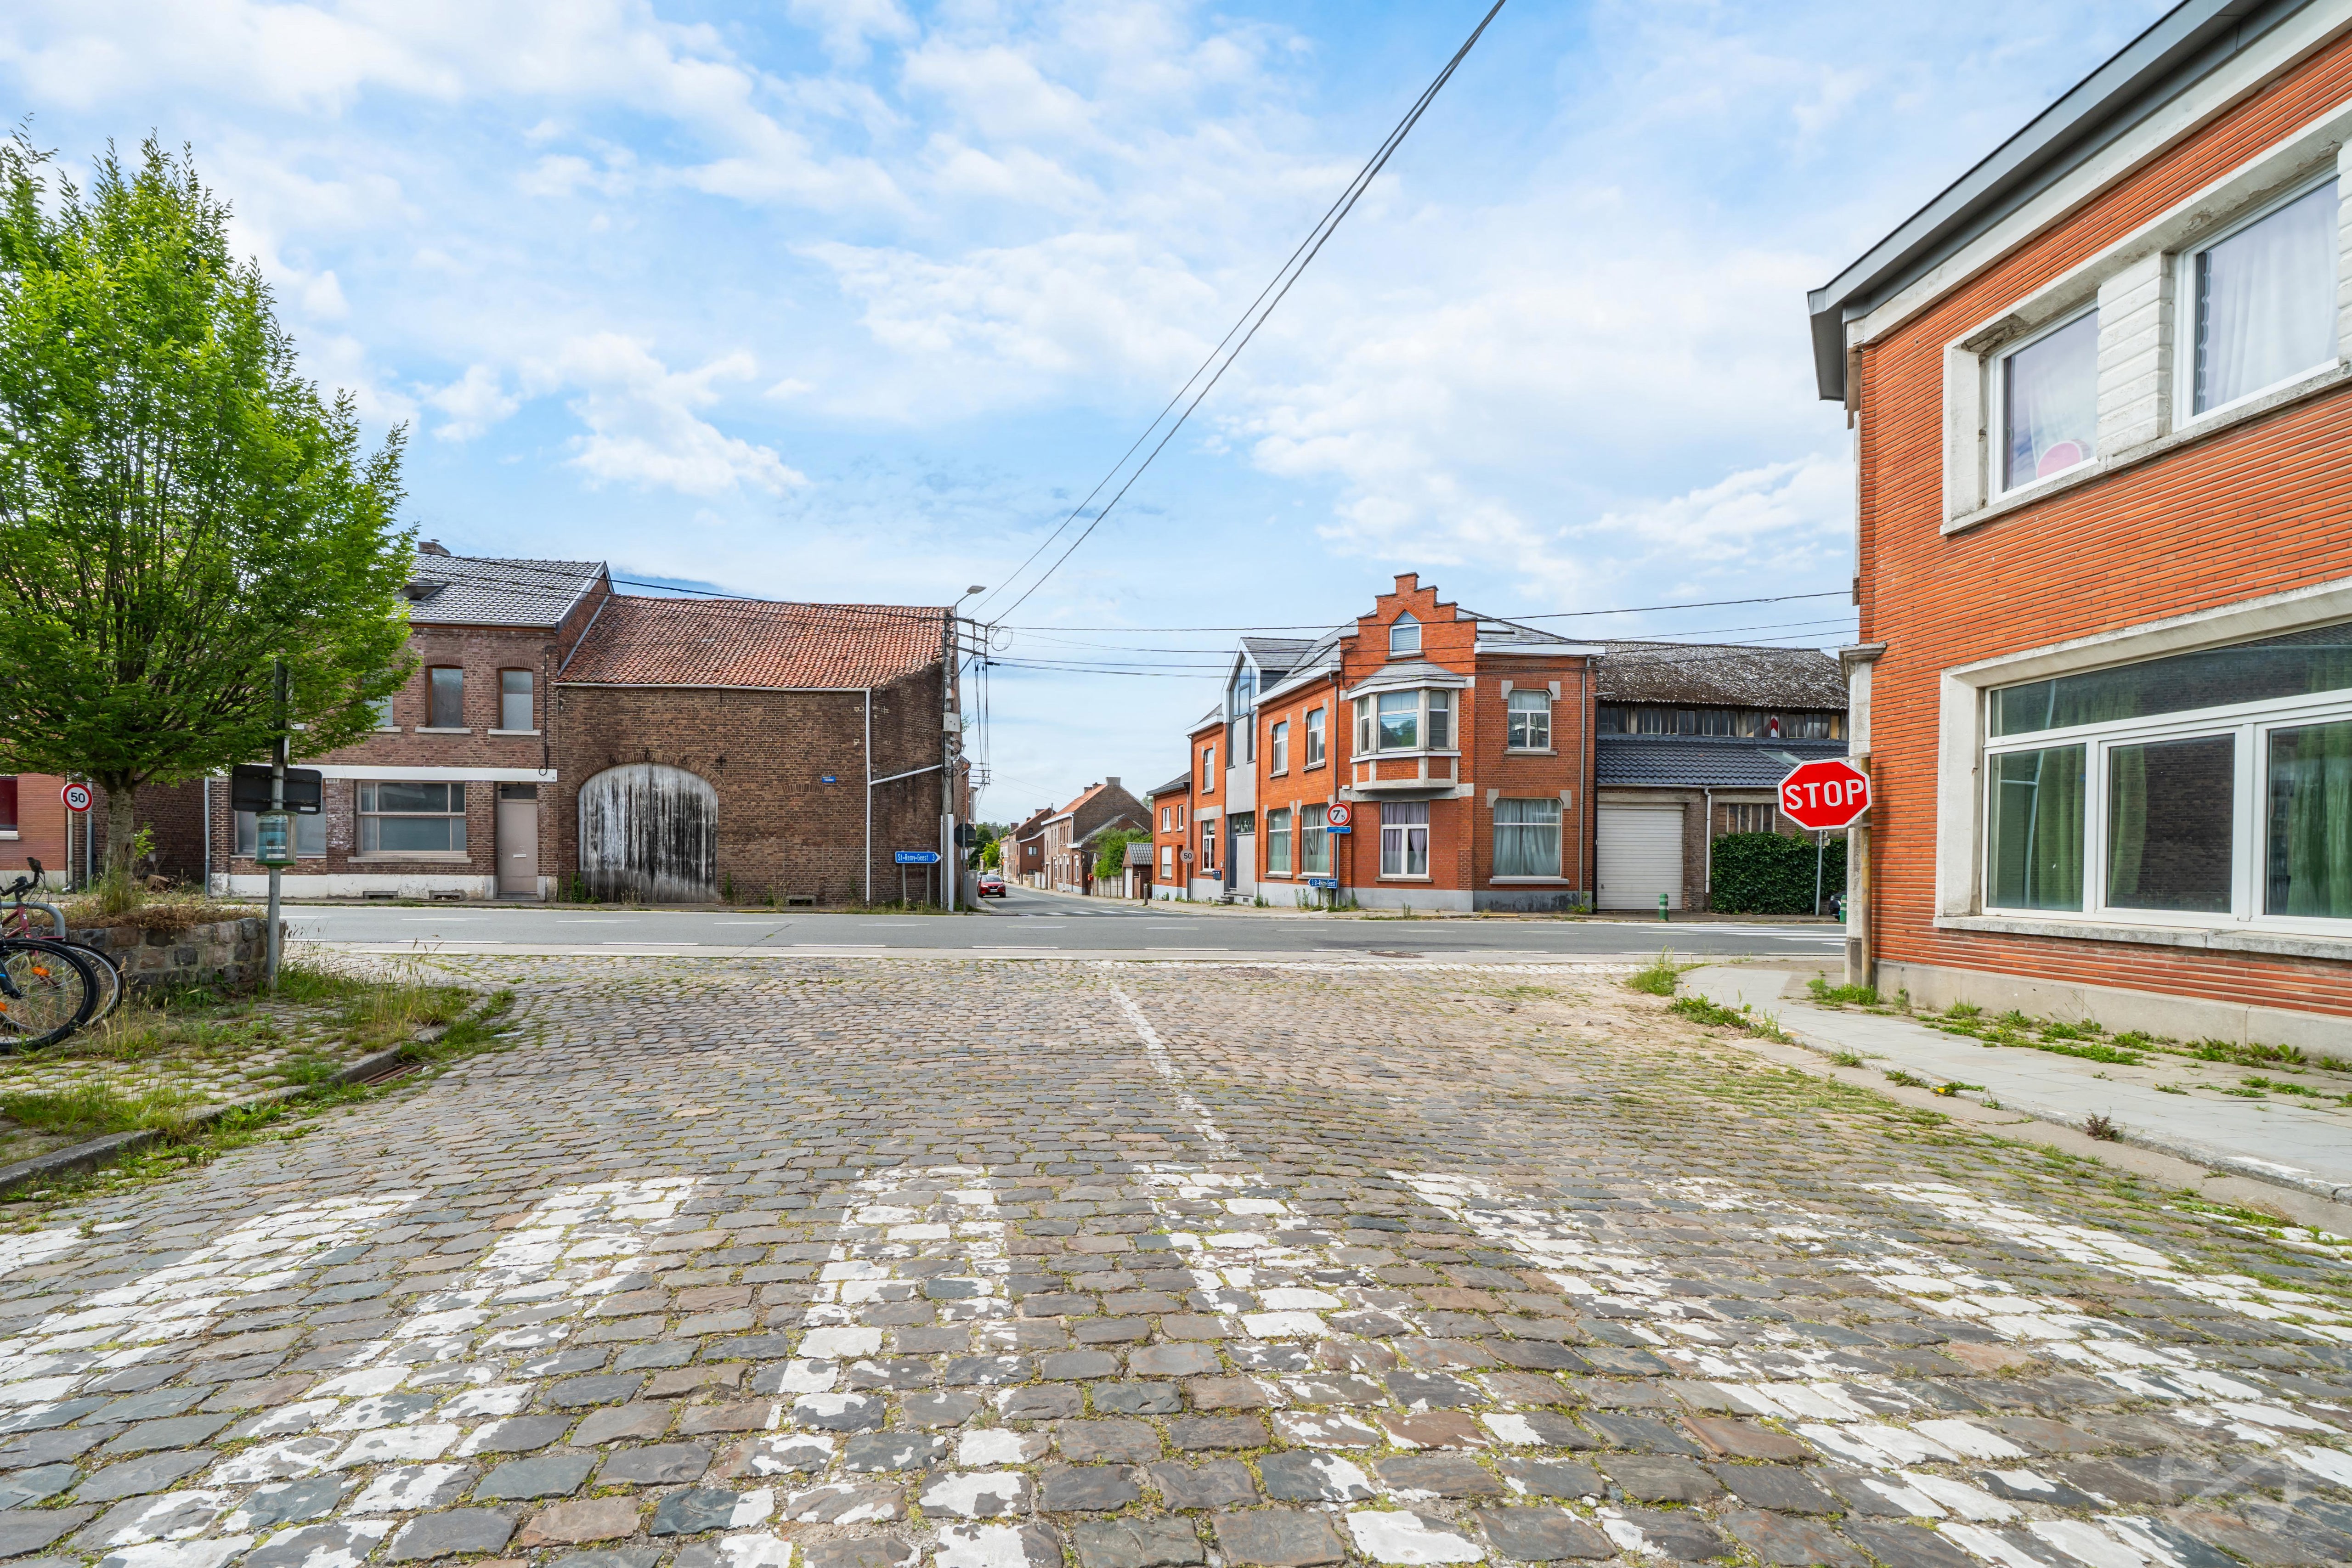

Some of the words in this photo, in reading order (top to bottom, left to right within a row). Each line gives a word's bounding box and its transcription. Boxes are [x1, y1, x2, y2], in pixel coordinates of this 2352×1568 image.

[71, 792, 85, 803] 50
[1785, 779, 1864, 810] STOP
[898, 853, 928, 862] St-Remy-Geest
